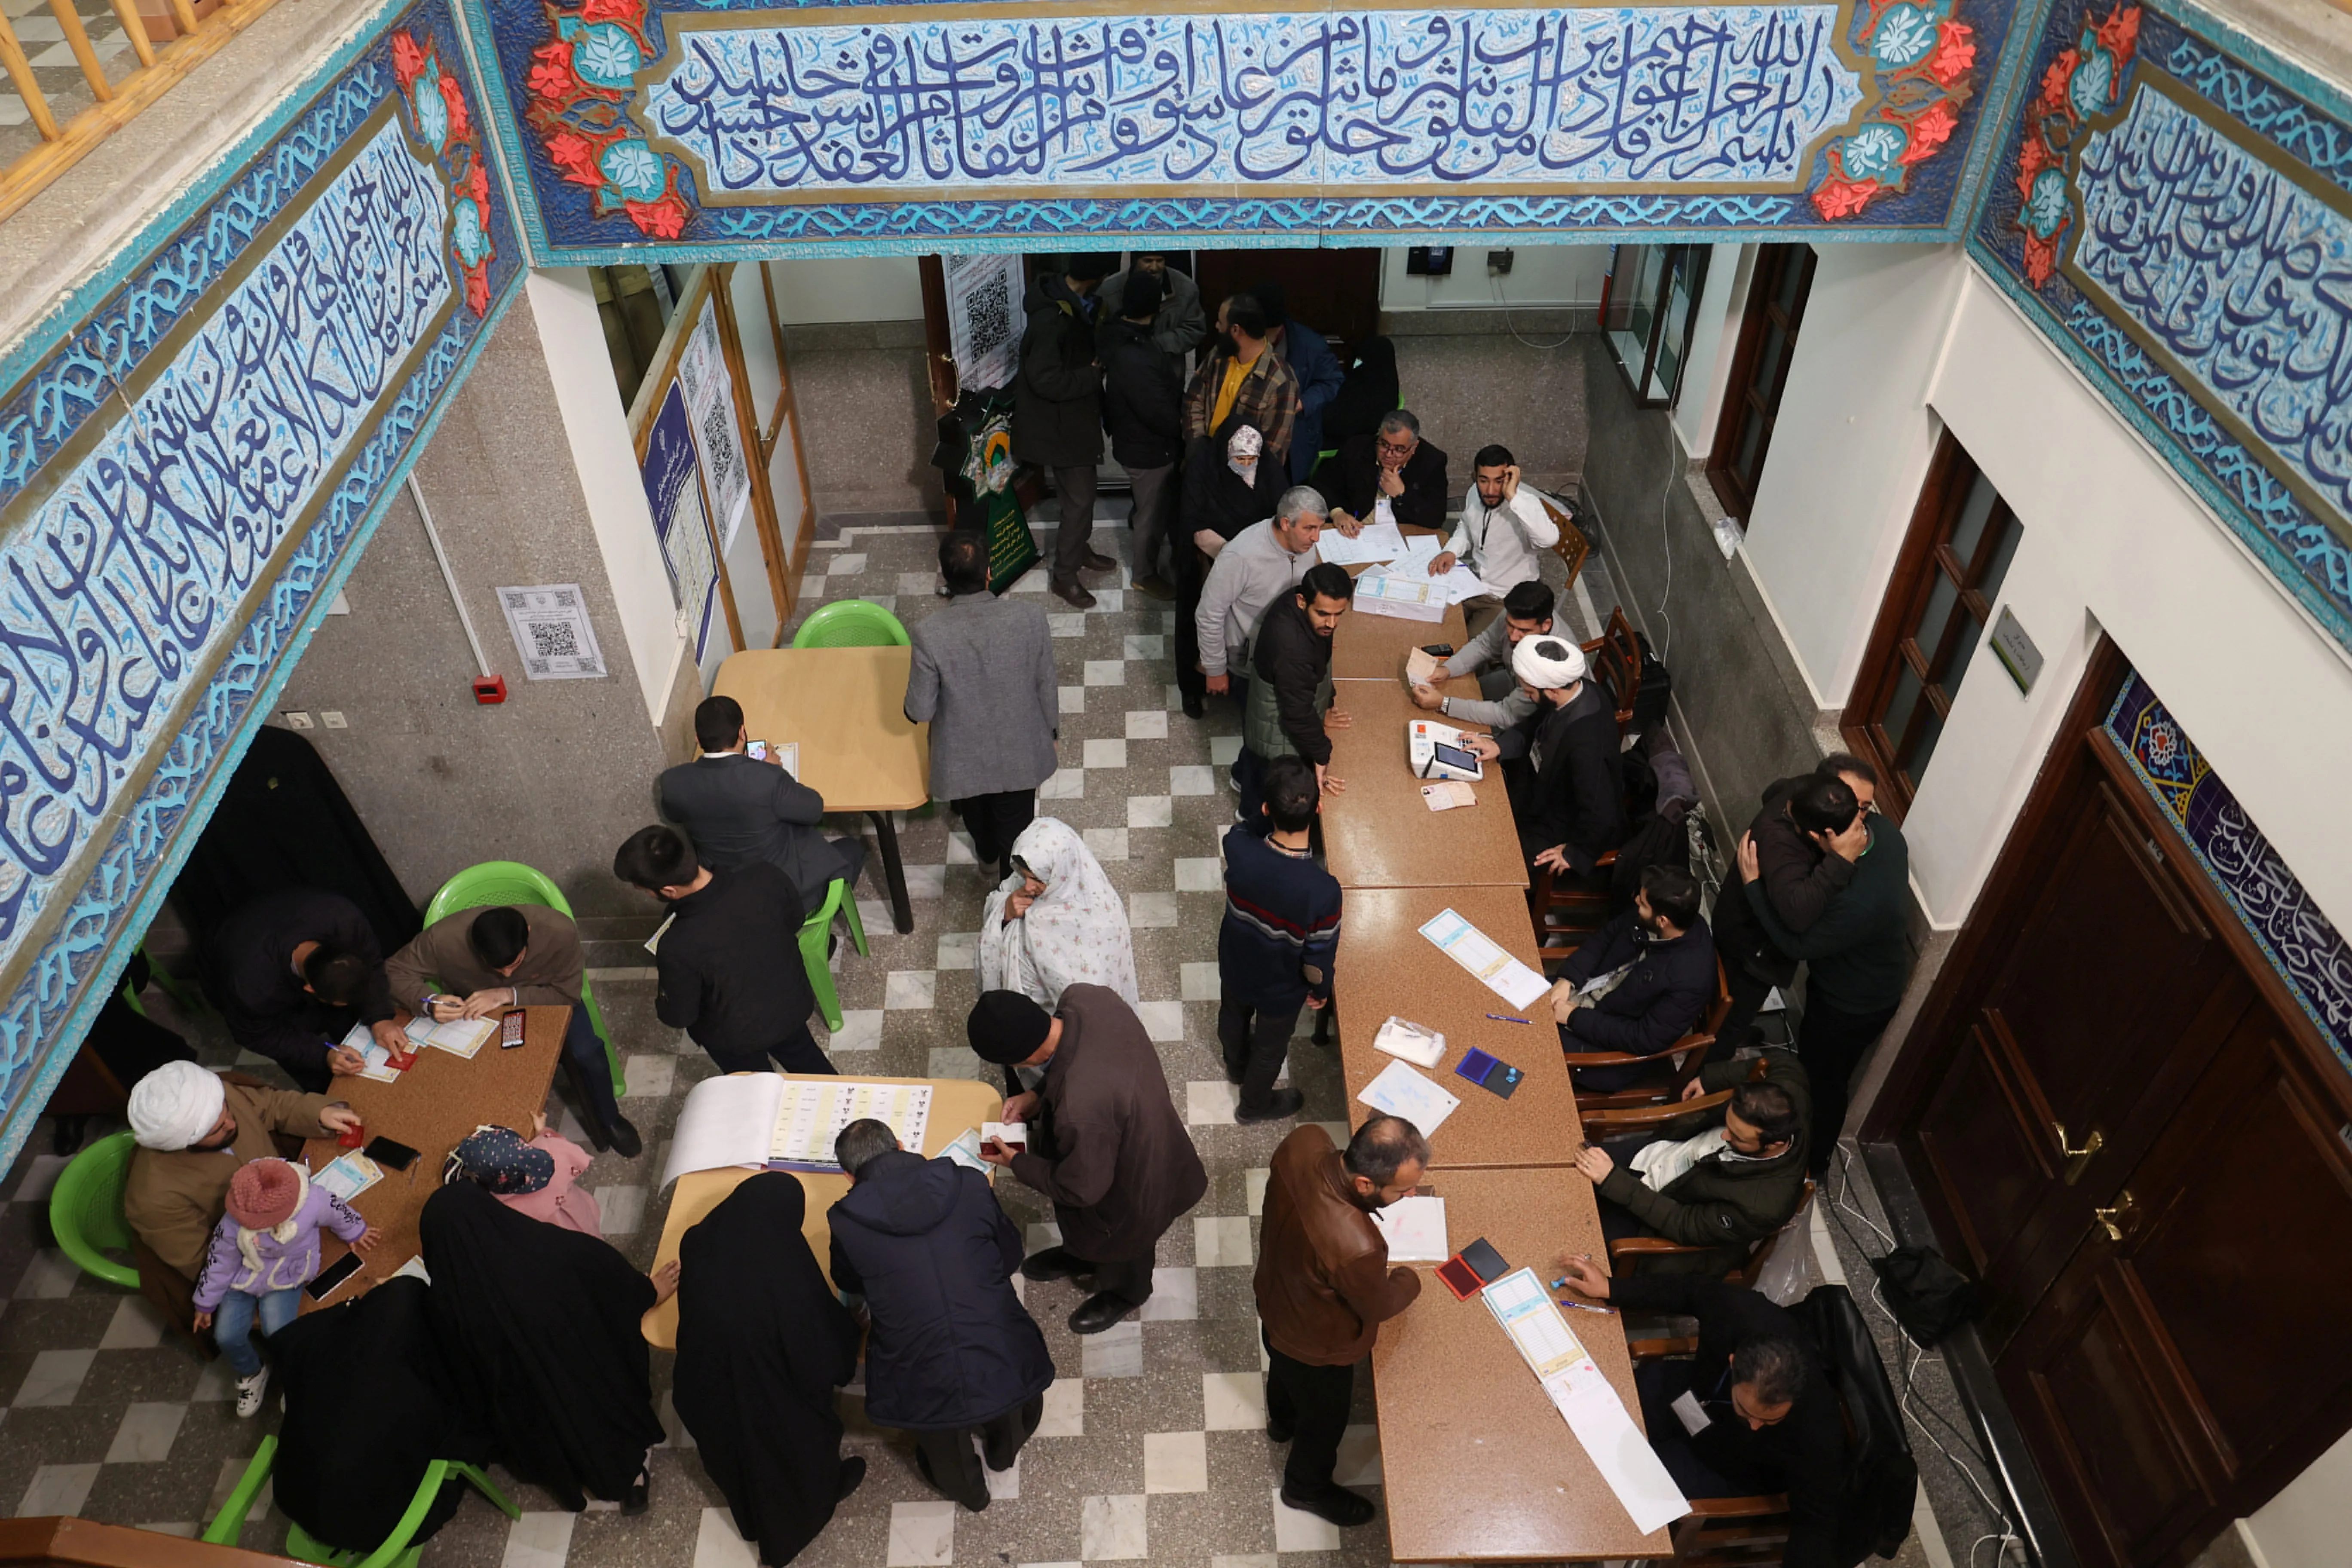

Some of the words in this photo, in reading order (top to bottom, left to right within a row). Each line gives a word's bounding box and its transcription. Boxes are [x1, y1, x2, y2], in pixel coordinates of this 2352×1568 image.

[1730, 12, 1823, 108] الله
[1670, 121, 1795, 180] بسم
[404, 241, 448, 345] بسم
